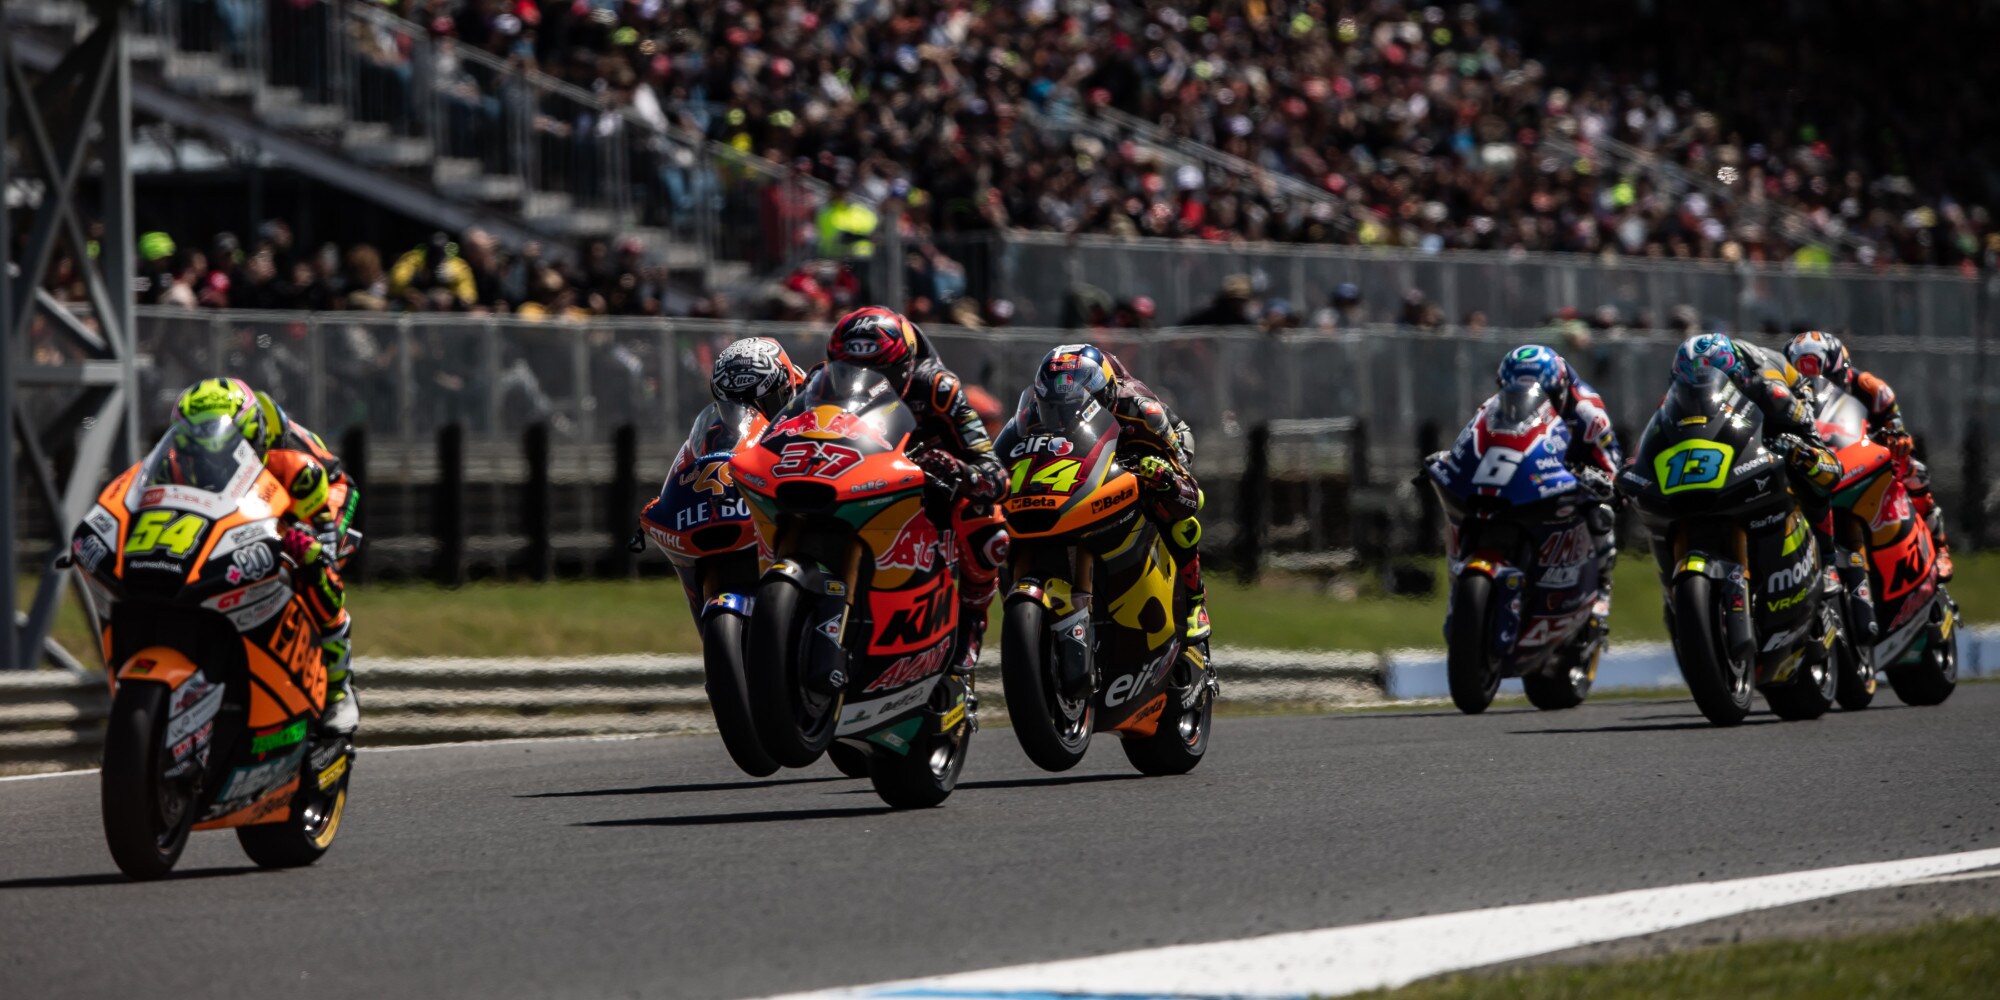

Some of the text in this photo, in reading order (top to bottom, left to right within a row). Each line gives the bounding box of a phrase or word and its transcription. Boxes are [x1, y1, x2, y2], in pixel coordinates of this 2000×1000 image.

[771, 441, 865, 480] 37
[1010, 437, 1049, 458] elf
[1472, 446, 1524, 486] 6
[1010, 457, 1083, 494] 14
[1666, 448, 1725, 489] 13
[1023, 497, 1056, 508] Beta
[1103, 489, 1134, 509] Beta
[124, 510, 207, 557] 54
[649, 526, 685, 550] STIHL
[874, 582, 954, 646] KTM
